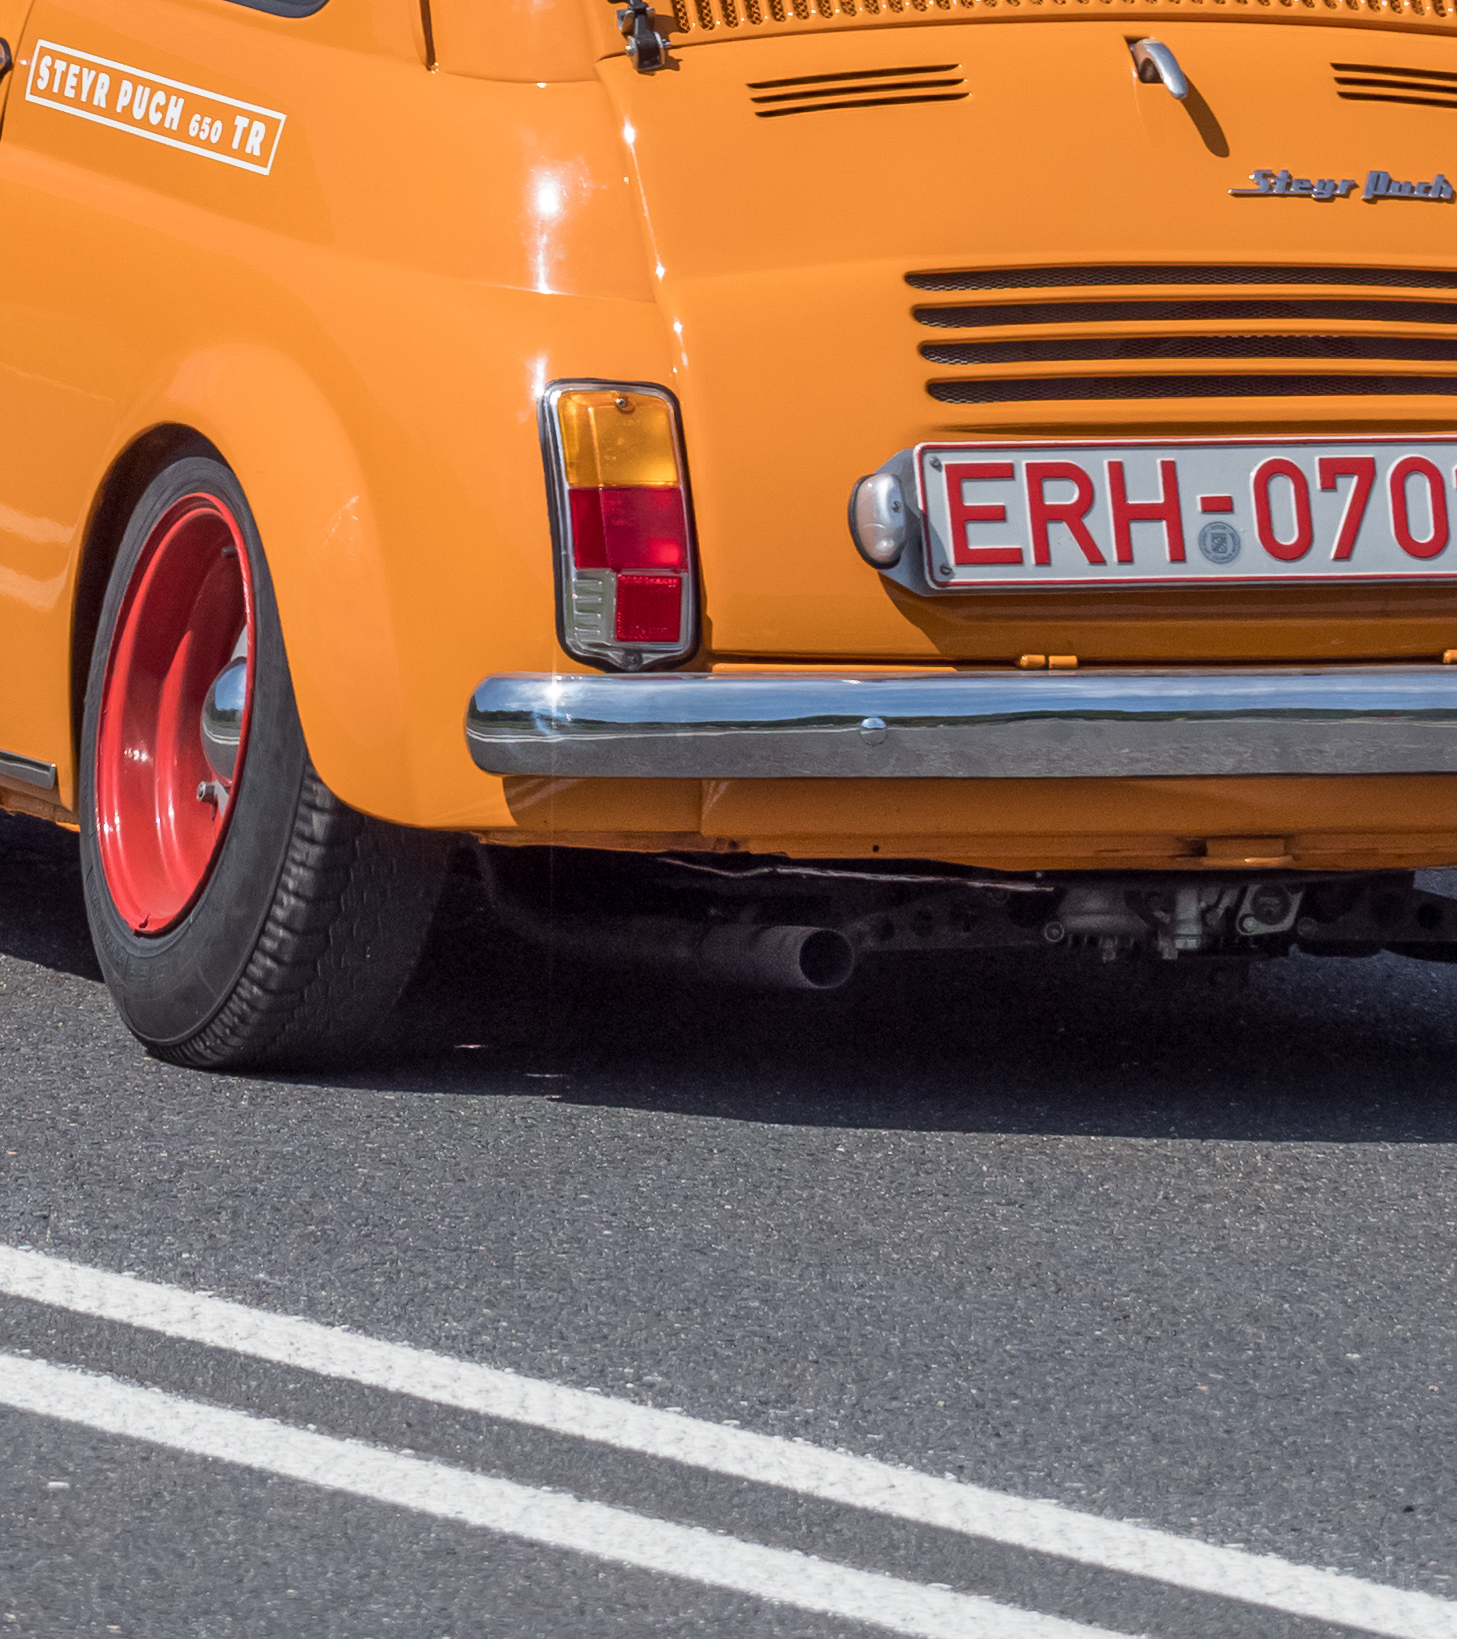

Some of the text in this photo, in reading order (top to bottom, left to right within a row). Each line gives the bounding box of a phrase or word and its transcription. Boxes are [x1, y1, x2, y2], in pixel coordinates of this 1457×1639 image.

[37, 55, 266, 156] STEYR PUCH 650 TR
[1228, 170, 1356, 199] Steyr
[1360, 170, 1454, 200] Puch
